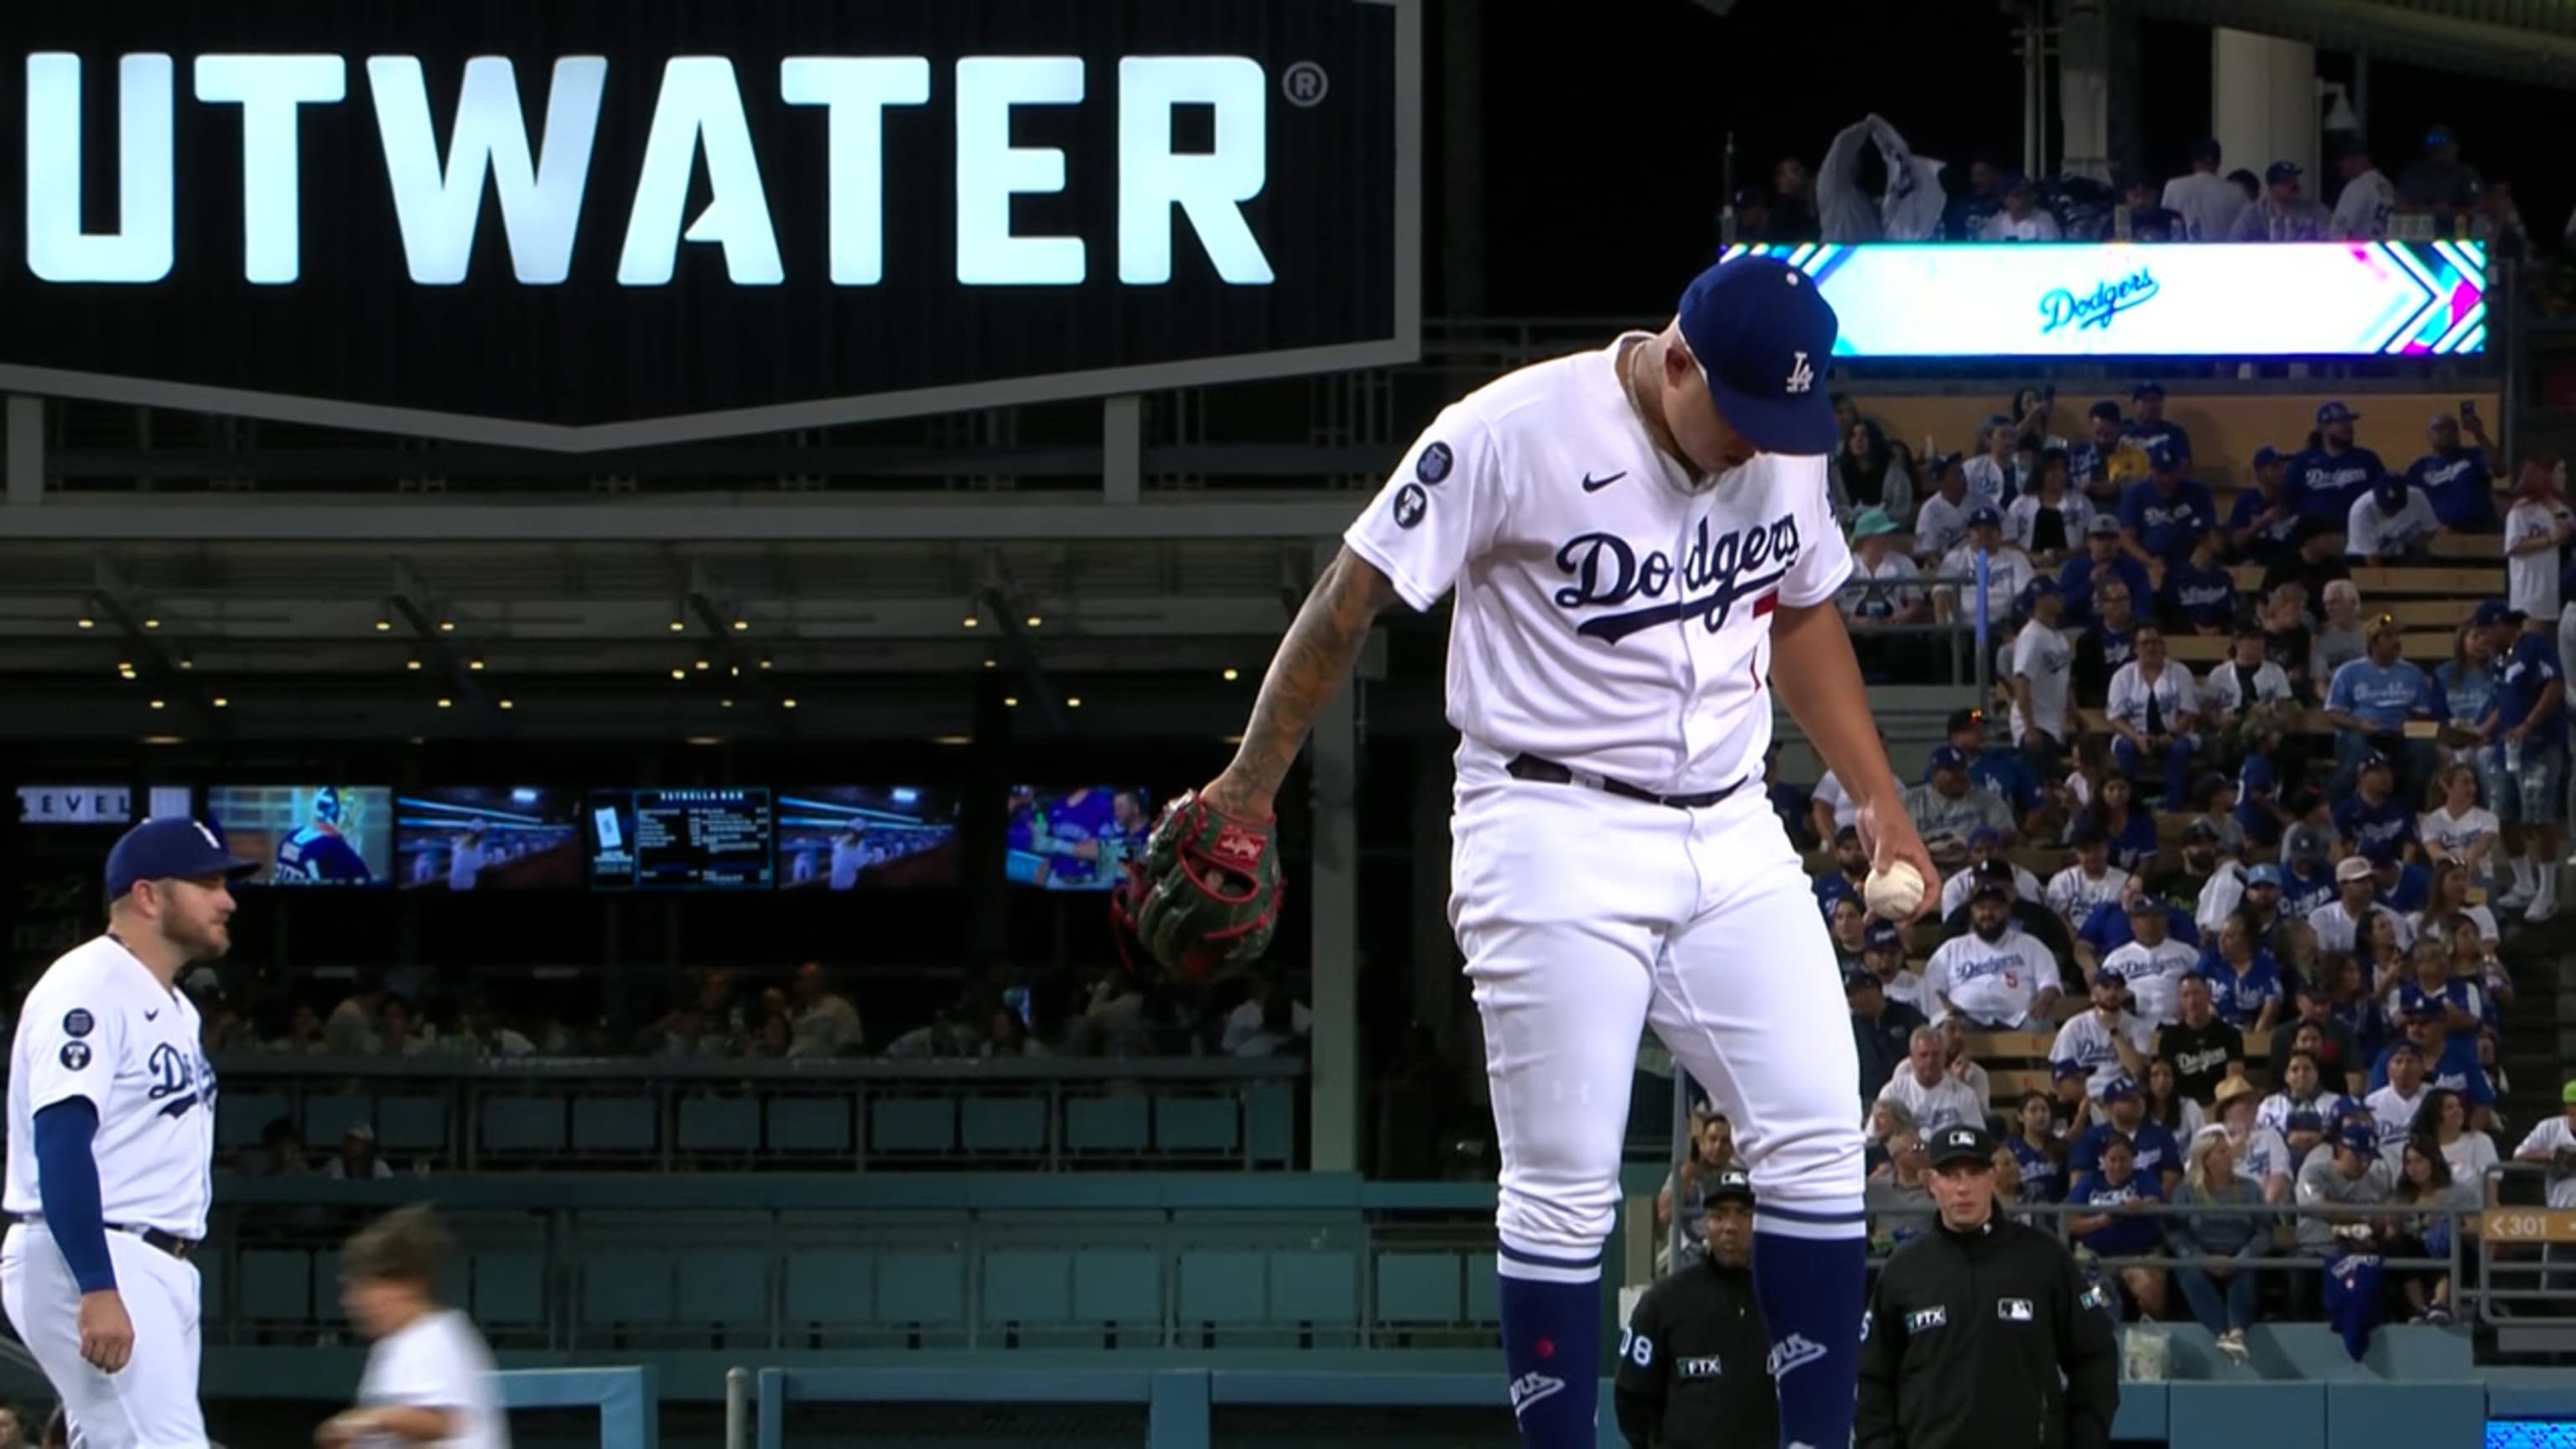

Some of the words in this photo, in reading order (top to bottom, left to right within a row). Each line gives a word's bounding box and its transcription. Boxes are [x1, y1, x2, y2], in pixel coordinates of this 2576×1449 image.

[26, 53, 1275, 284] UTWATER
[2039, 266, 2159, 334] Dodgers
[1555, 512, 1800, 639] Dodgers
[2508, 1214, 2547, 1236] 301
